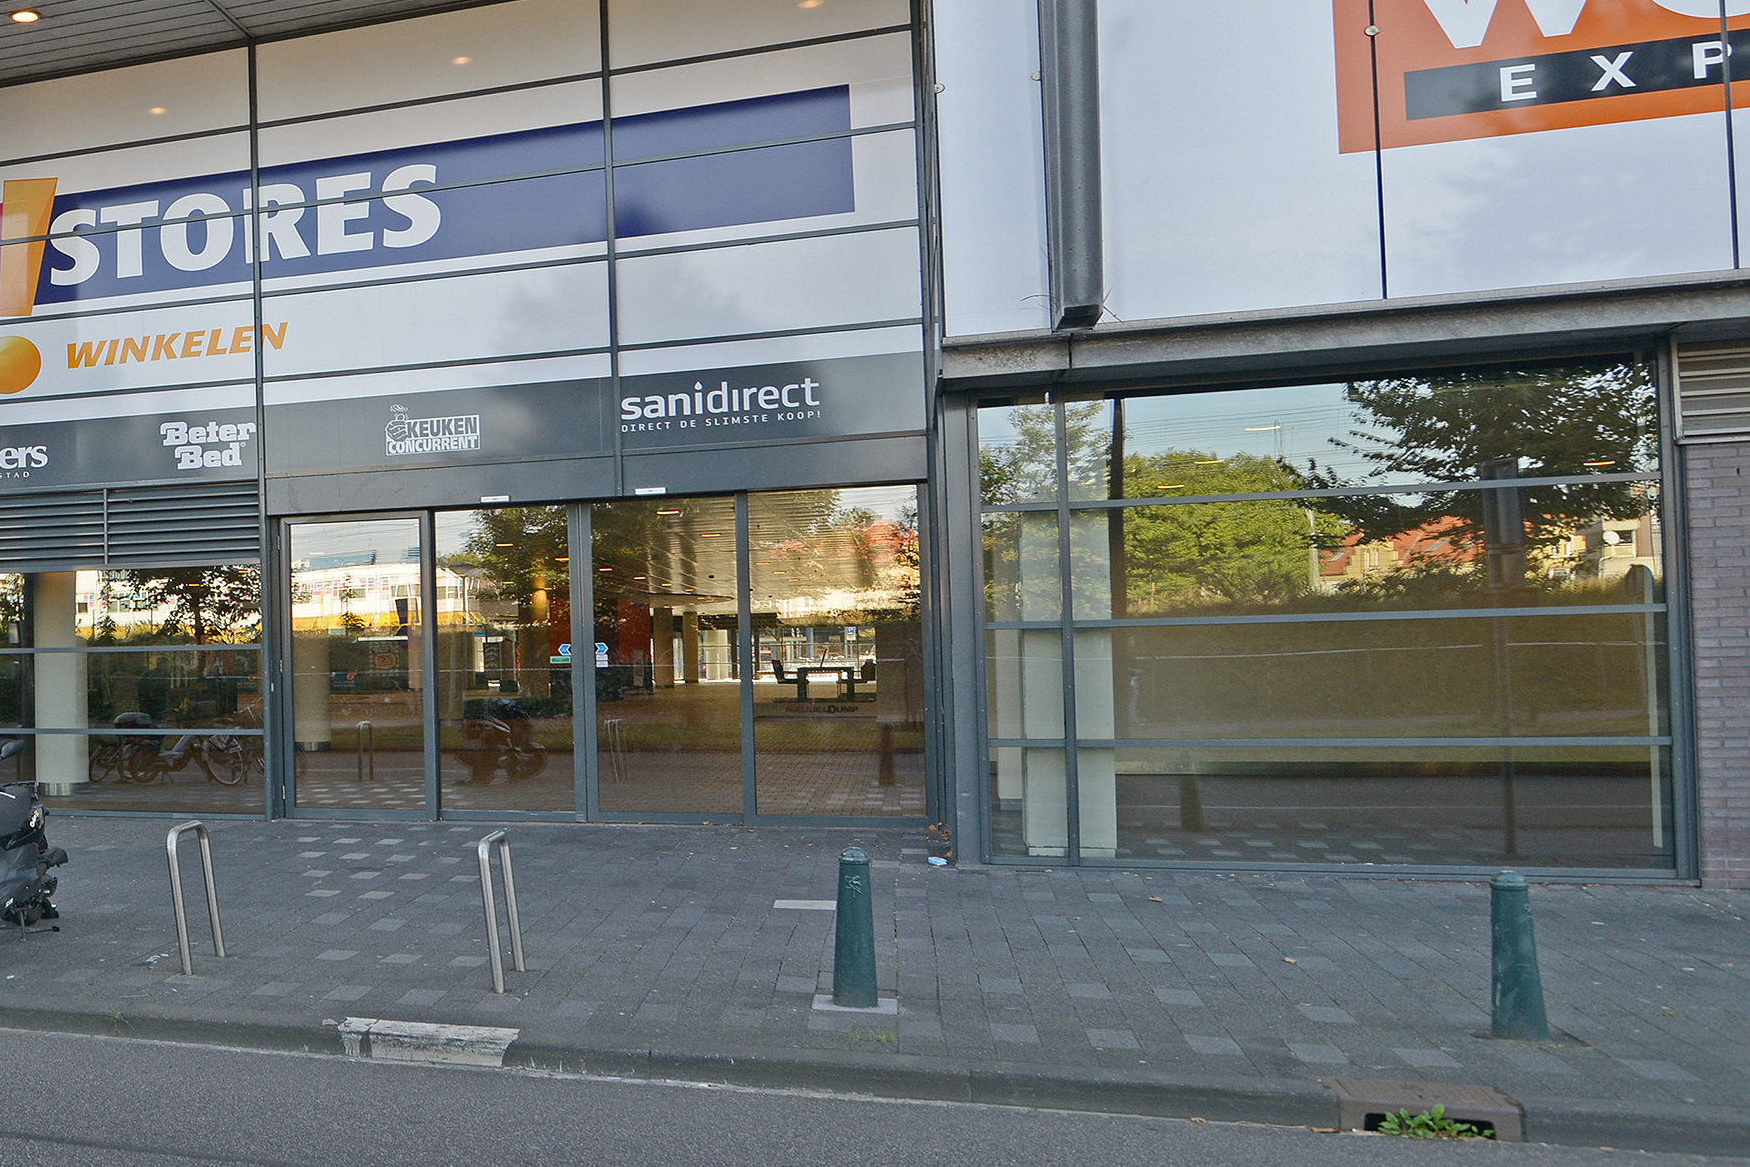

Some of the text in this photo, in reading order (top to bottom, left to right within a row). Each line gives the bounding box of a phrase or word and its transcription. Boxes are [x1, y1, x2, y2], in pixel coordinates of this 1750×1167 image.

[1499, 41, 1733, 102] EXP
[50, 164, 442, 286] STORES
[66, 321, 289, 370] WINKELEN
[620, 377, 821, 421] sanidirect
[159, 421, 256, 447] Beter
[407, 416, 477, 439] KEUKEN
[621, 410, 822, 433] DIRECT DE SLIMSTE KOOP!
[174, 442, 243, 470] Bed
[388, 435, 478, 454] CONCURRENT
